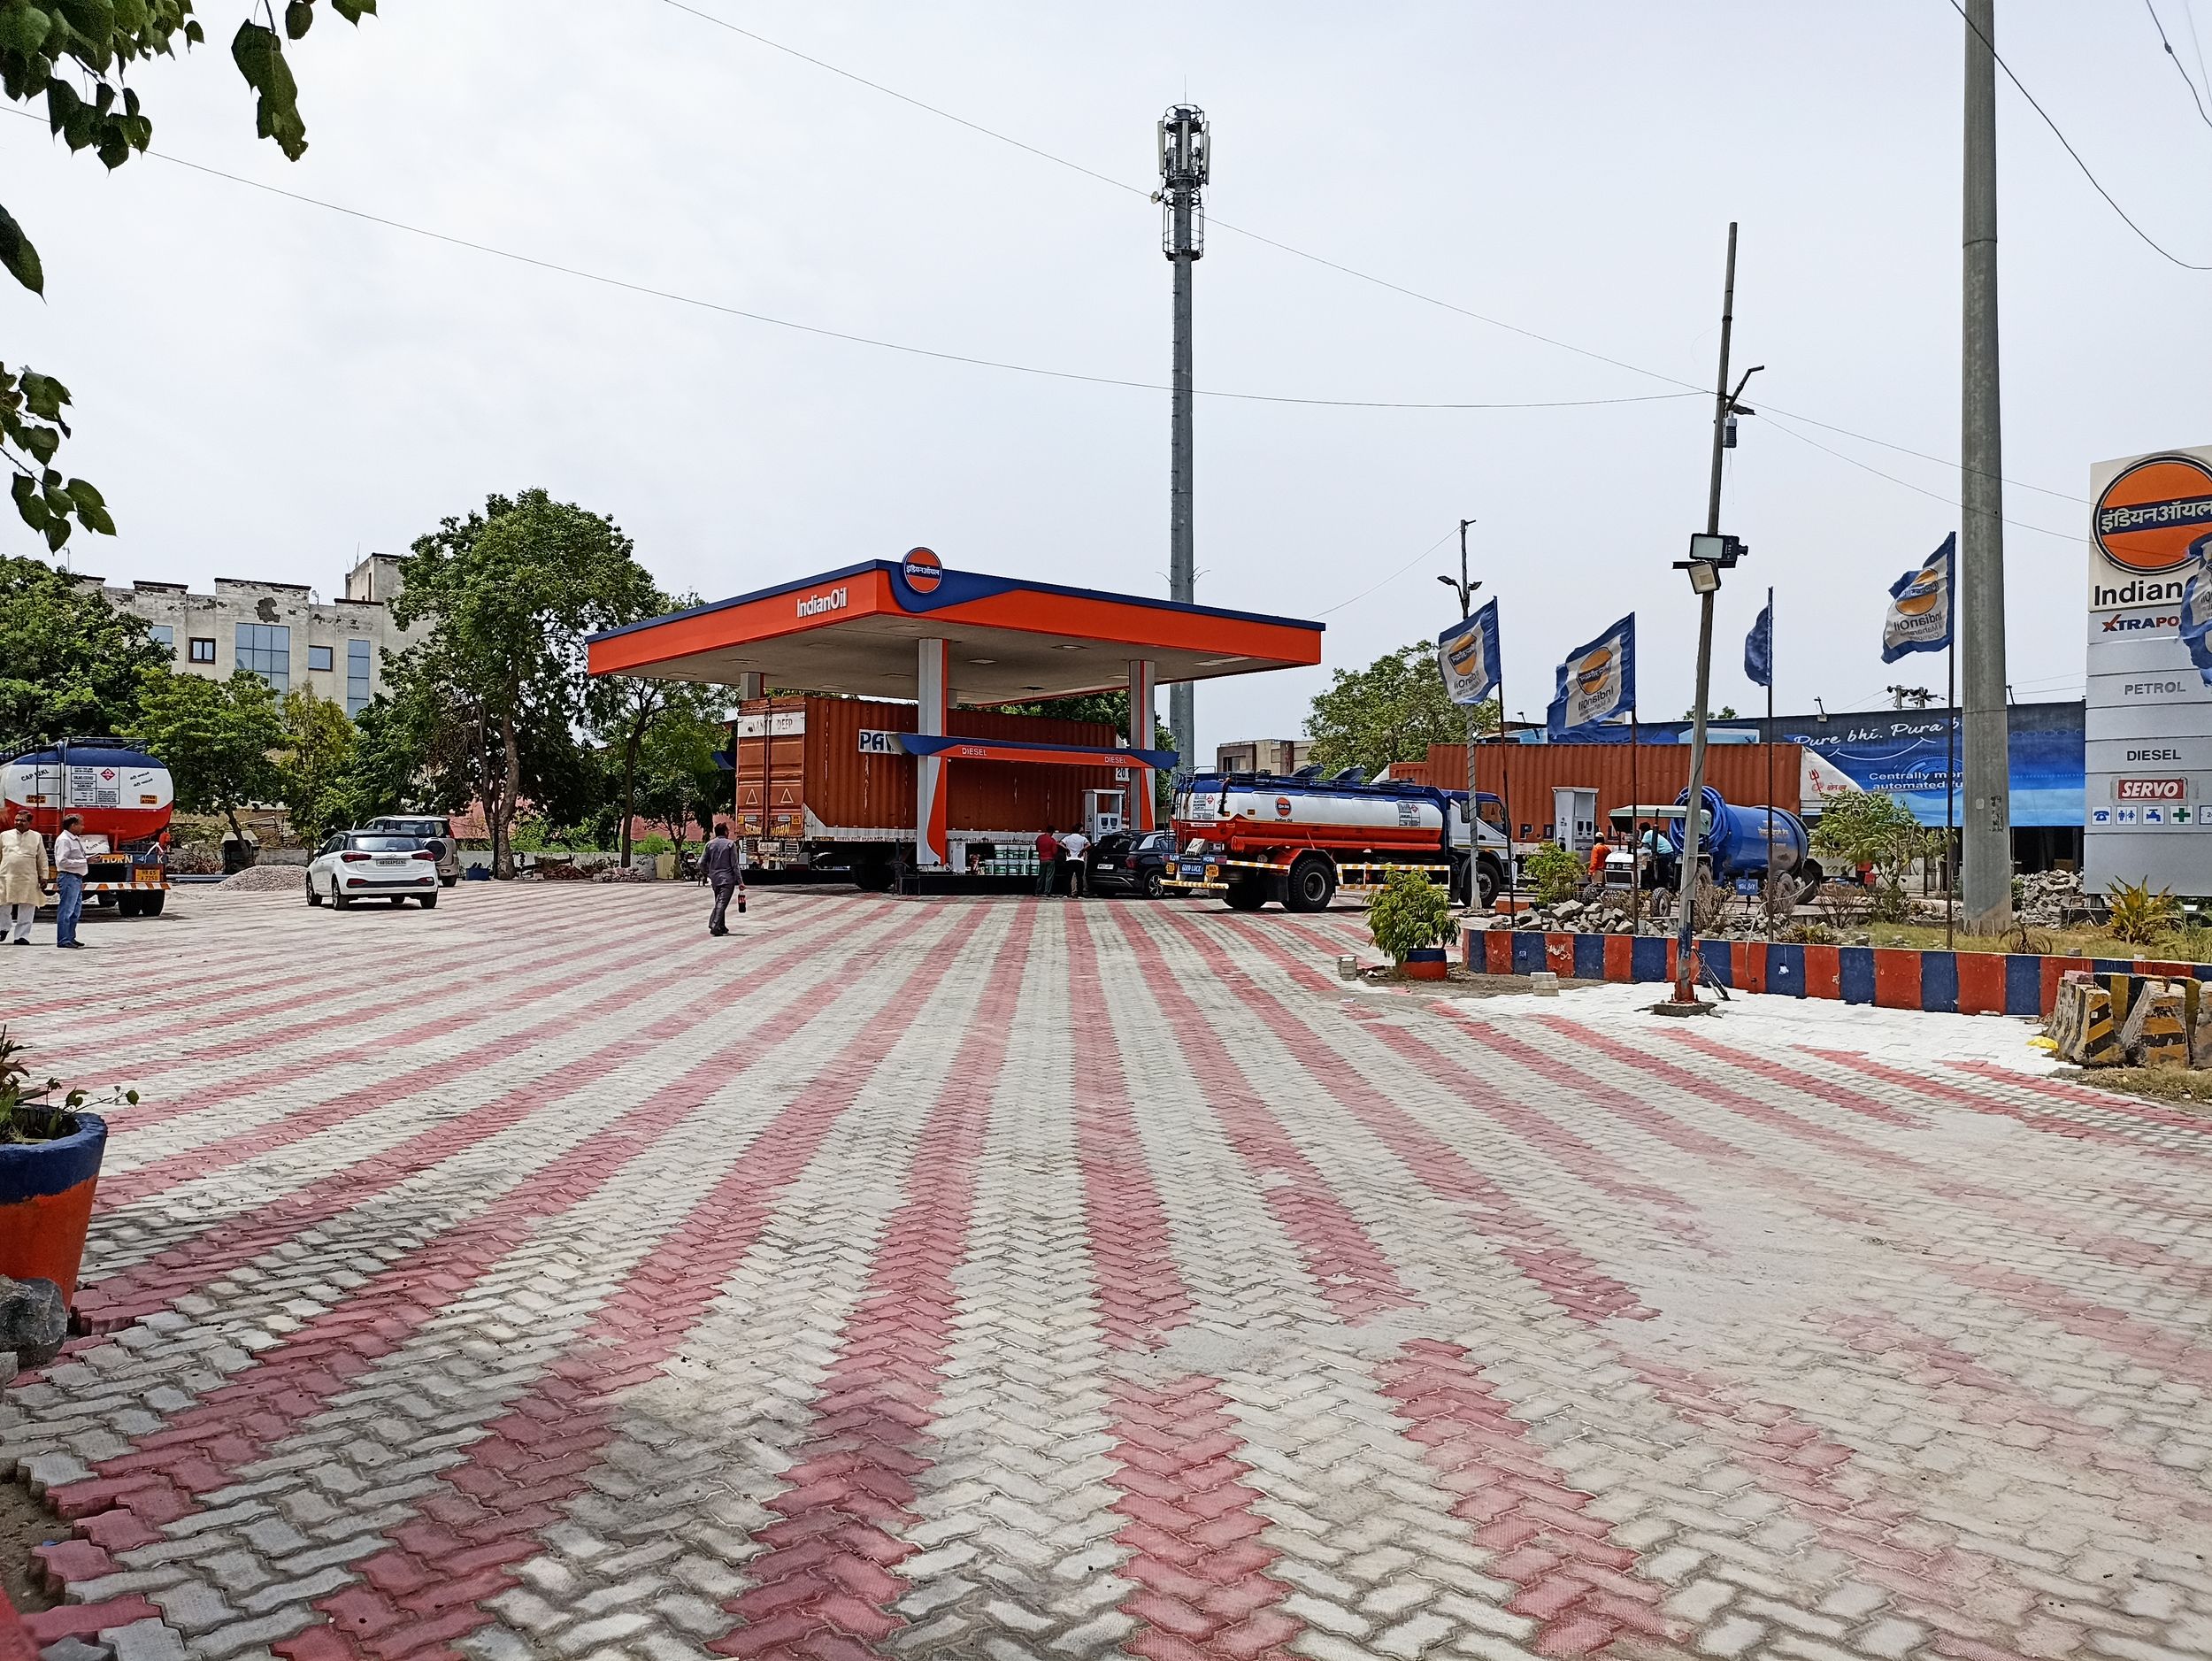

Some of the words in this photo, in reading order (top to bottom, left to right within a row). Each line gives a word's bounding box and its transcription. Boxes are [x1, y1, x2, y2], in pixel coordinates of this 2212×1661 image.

[2094, 579, 2187, 606] Indian
[796, 588, 848, 619] IndianOil
[2101, 614, 2179, 632] XTRAPO
[2124, 681, 2186, 696] PETROL
[1793, 735, 1841, 747] Pure
[1890, 722, 1944, 737] Pura
[962, 748, 987, 757] DIESEL
[2126, 750, 2182, 762] DIESEL
[1869, 772, 1931, 781] Centrally
[2121, 781, 2179, 797] SERVO
